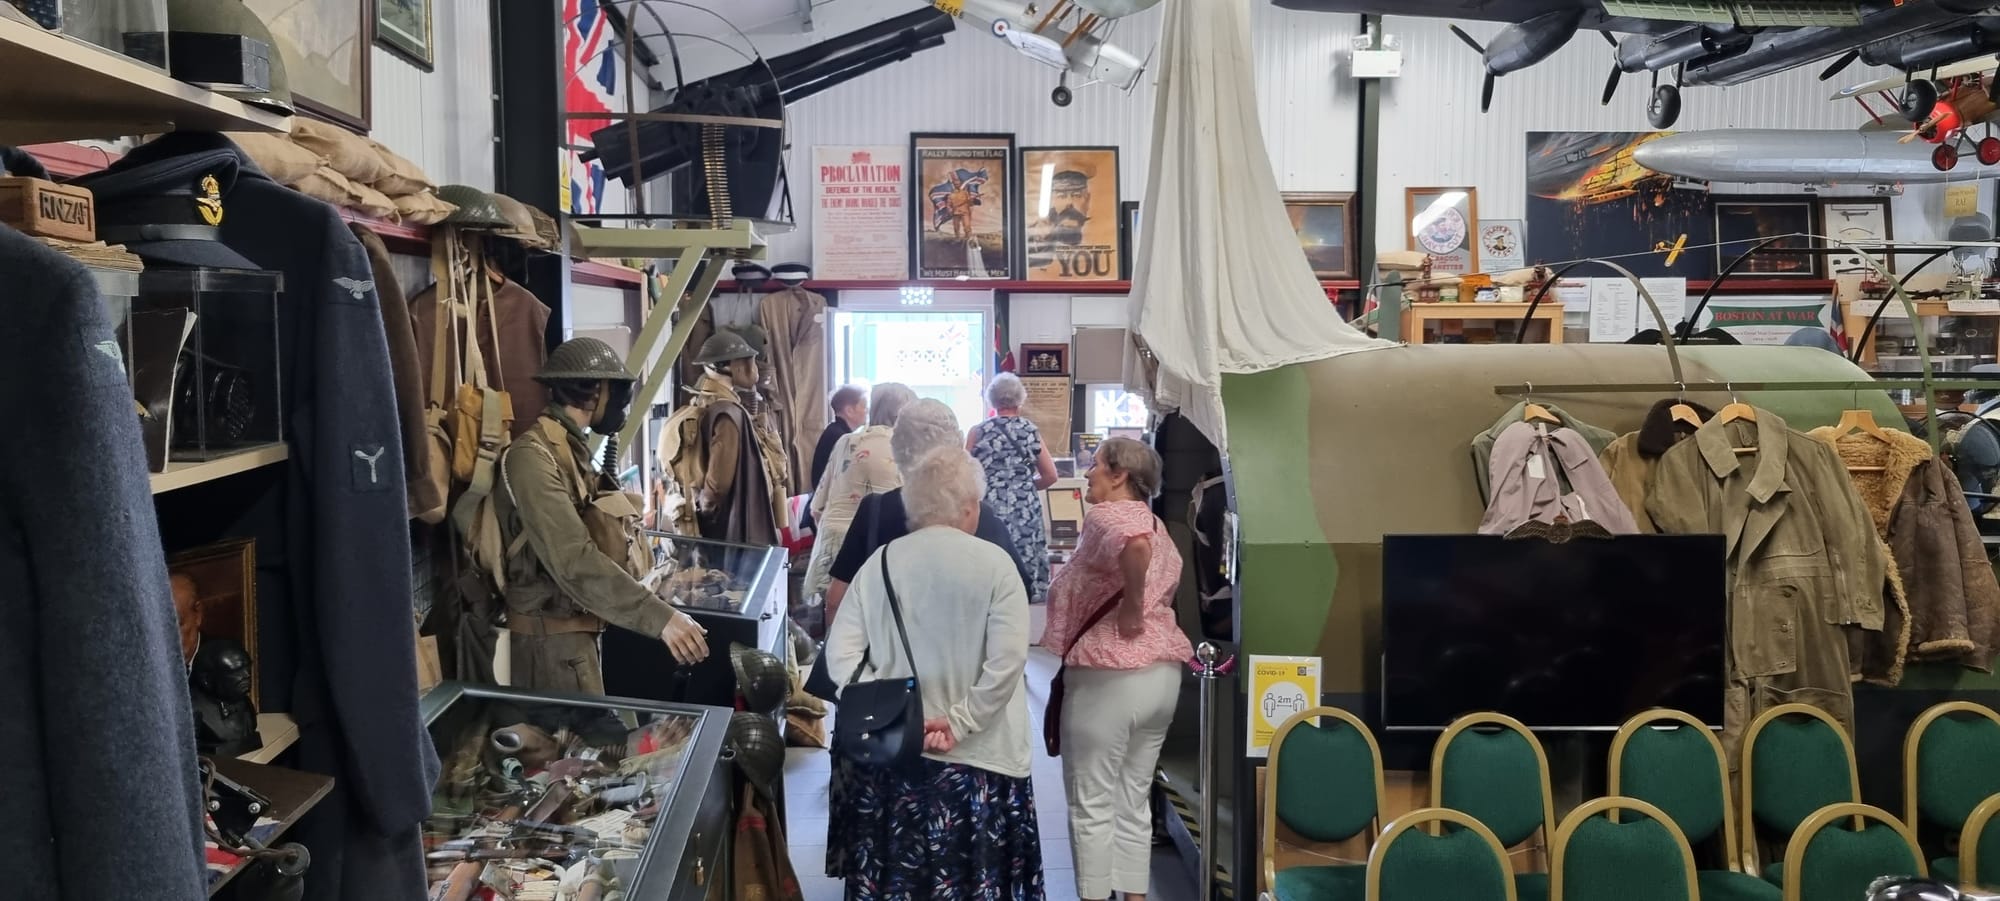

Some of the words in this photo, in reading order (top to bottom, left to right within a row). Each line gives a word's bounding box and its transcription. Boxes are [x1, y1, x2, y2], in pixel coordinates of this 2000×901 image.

[986, 149, 1004, 157] FLAG
[820, 165, 901, 182] PROCLAMATION
[39, 191, 88, 225] RNZAF
[1447, 233, 1462, 249] CUT
[1056, 250, 1113, 277] YOU
[1715, 312, 1765, 321] BOSTON
[1768, 311, 1784, 321] AT
[1787, 311, 1816, 320] WAR
